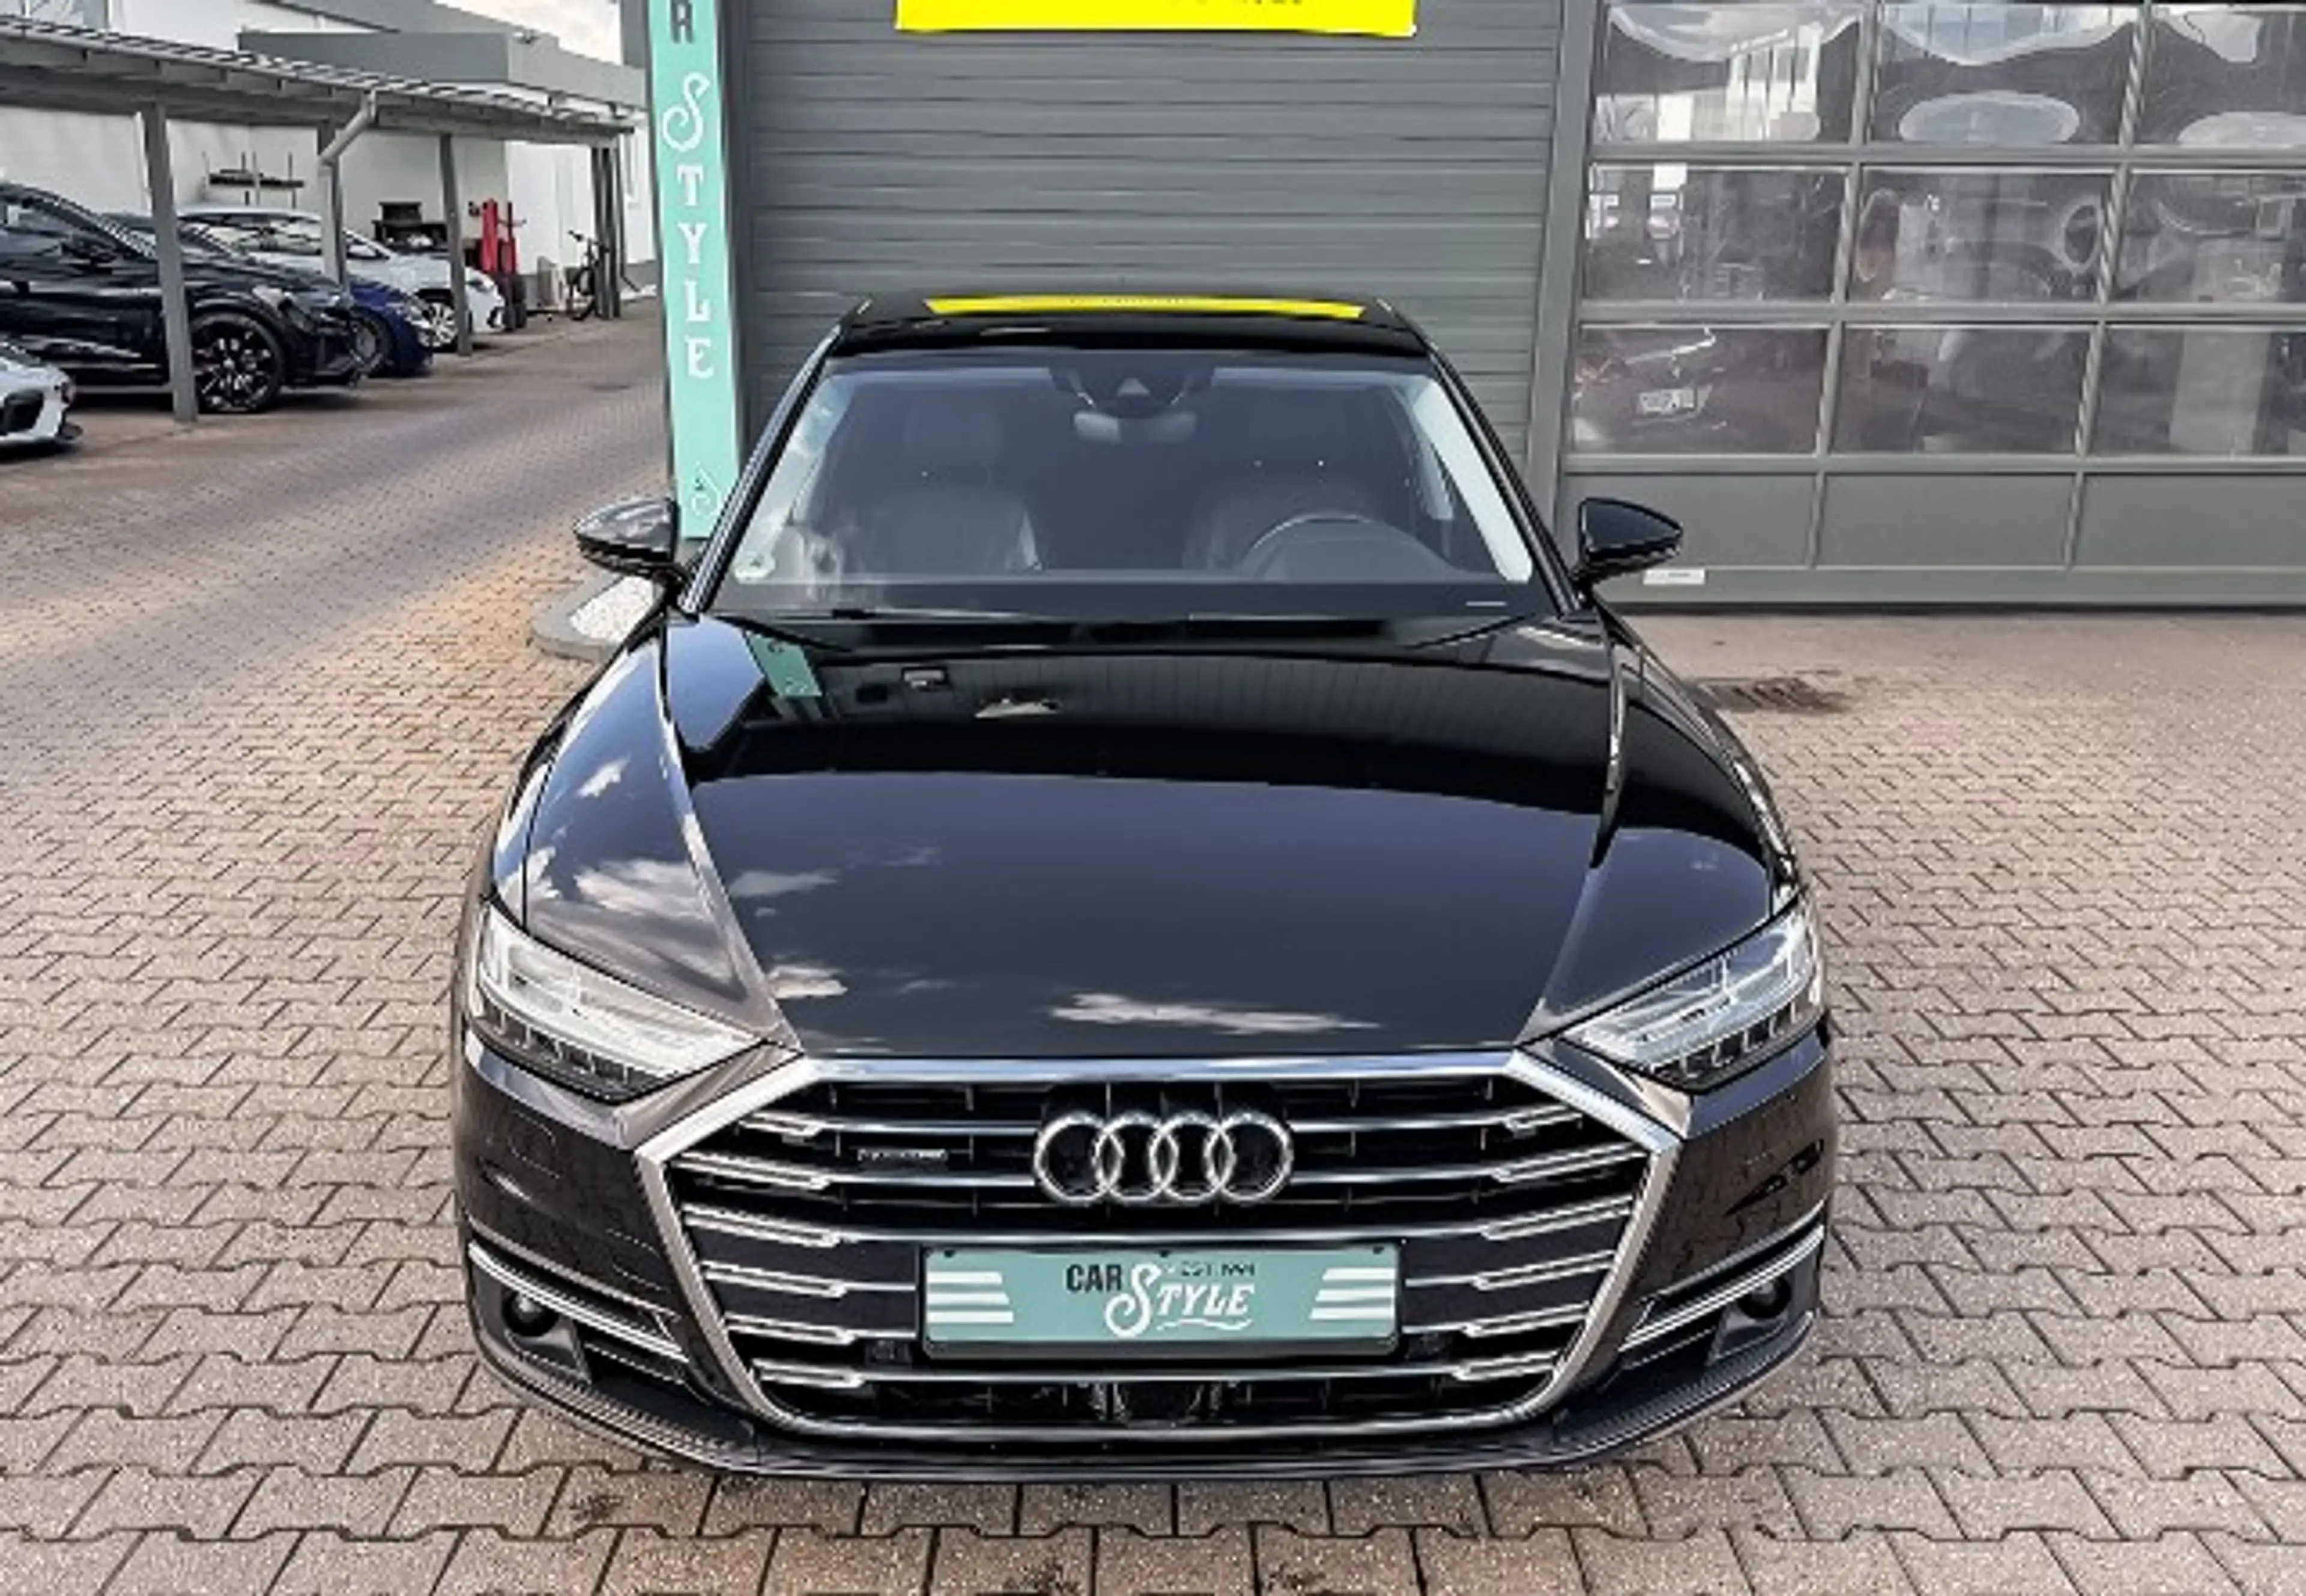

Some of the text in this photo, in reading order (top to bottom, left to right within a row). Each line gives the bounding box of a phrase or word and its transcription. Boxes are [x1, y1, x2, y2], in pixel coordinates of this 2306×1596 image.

[662, 71, 714, 379] STYLE
[1066, 1263, 1255, 1338] CAR STYLE
